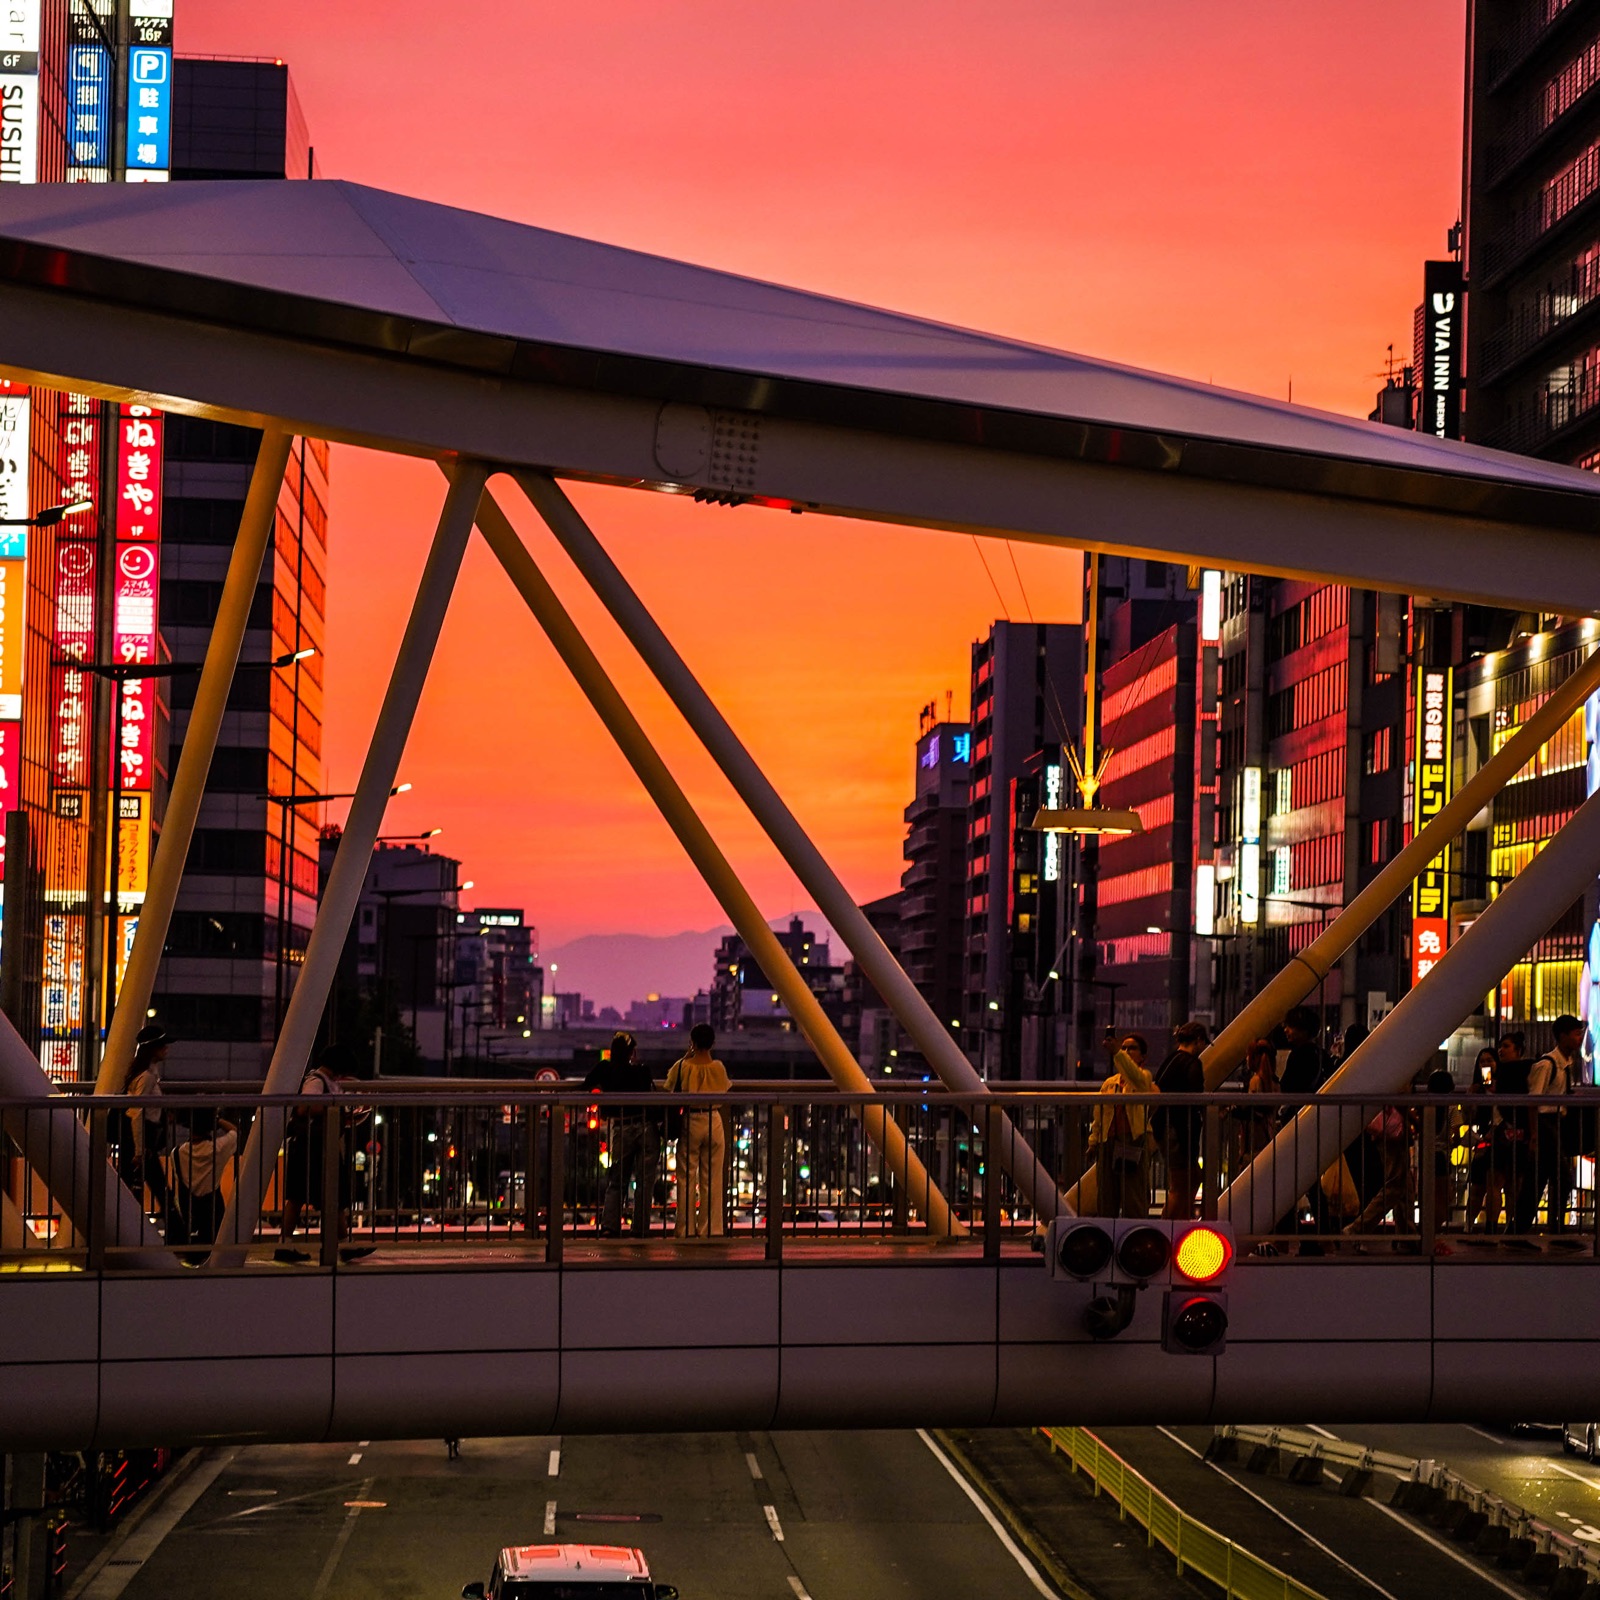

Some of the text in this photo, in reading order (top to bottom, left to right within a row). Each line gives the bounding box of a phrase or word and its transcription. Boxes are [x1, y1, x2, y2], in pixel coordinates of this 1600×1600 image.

[10, 0, 25, 43] ar
[134, 18, 169, 28] ルシアス
[140, 29, 162, 41] 16F
[3, 54, 21, 66] 6F
[140, 55, 160, 78] P
[2, 85, 23, 183] SUSHI
[138, 88, 159, 164] 駐車場
[1435, 318, 1451, 351] VIA
[1434, 356, 1450, 390] INN
[131, 525, 144, 537] 1F
[121, 643, 148, 663] 9F
[124, 777, 137, 787] 1F
